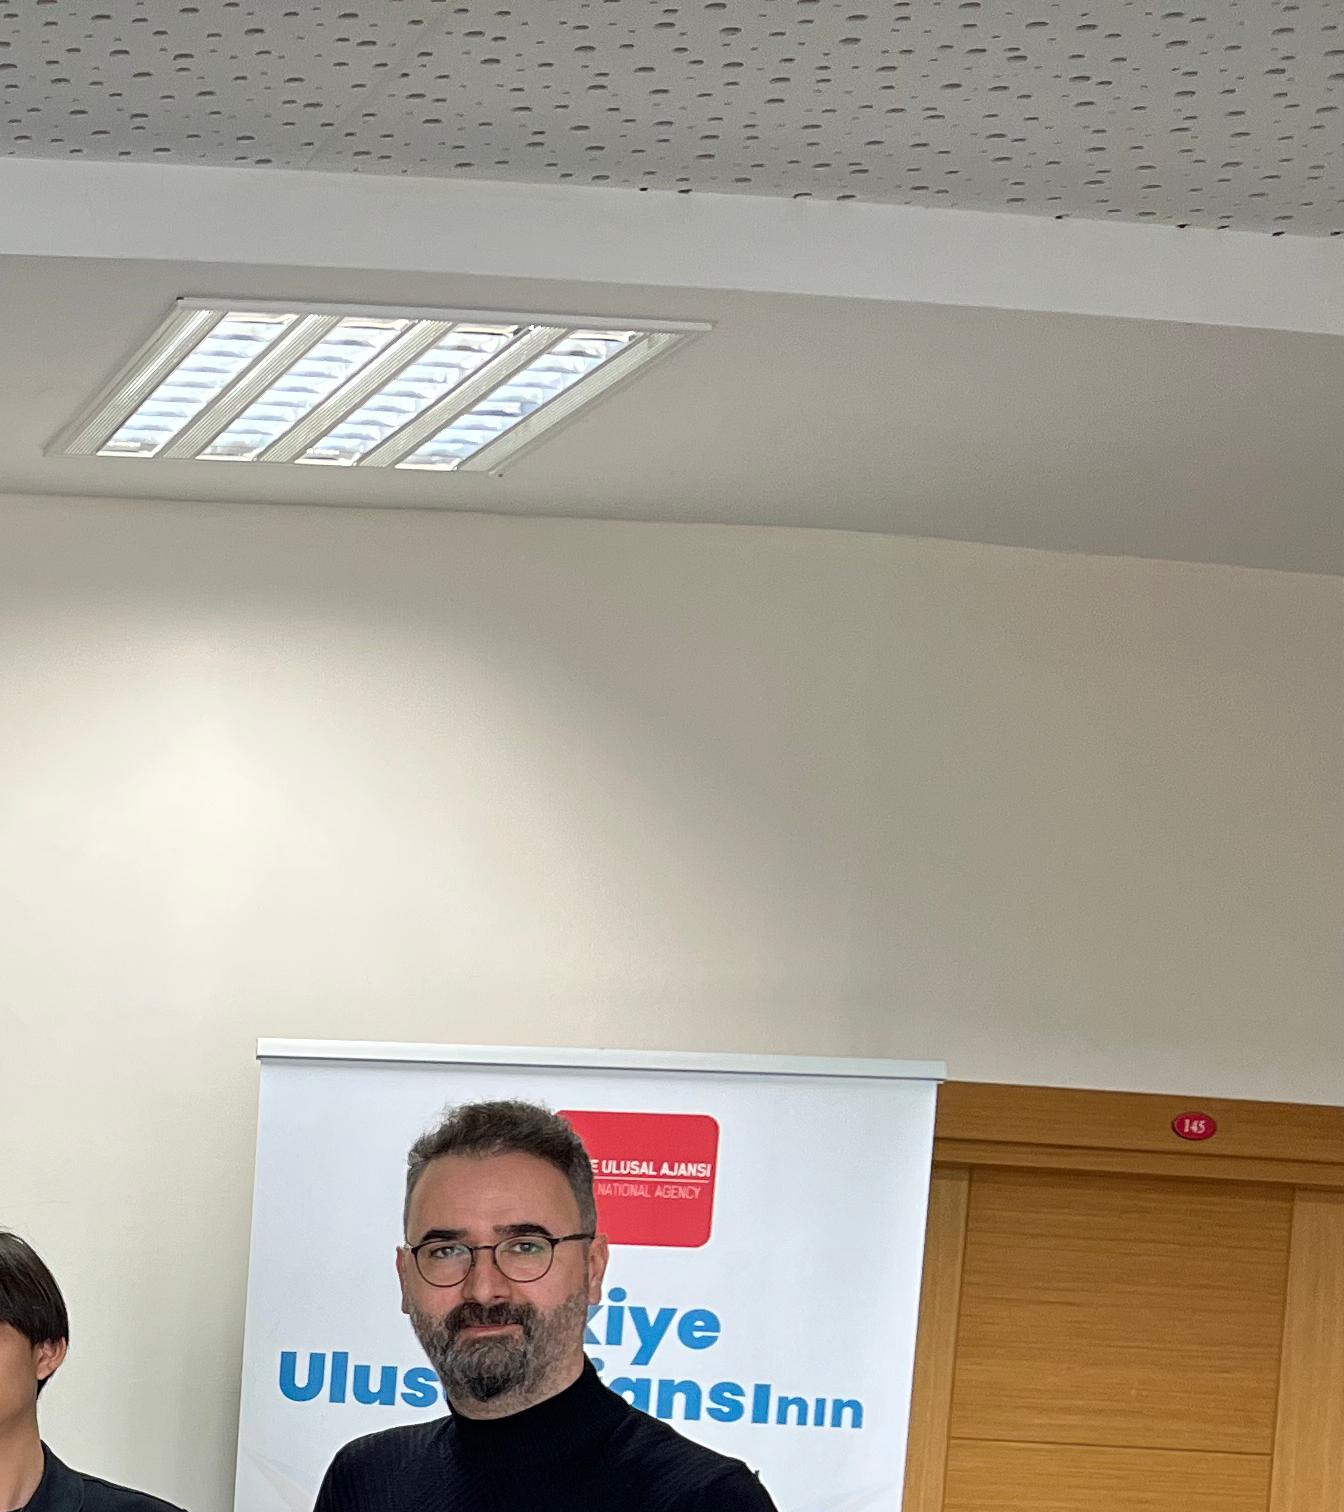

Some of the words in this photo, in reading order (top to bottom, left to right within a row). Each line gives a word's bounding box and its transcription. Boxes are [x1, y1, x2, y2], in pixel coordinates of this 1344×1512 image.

[1183, 1118, 1206, 1134] 145
[602, 1159, 657, 1176] ULUSAL
[660, 1162, 712, 1177] AJANSI
[597, 1182, 651, 1198] NATIONAL
[654, 1184, 702, 1200] AGENCY
[279, 1351, 444, 1408] Ulus
[596, 1362, 863, 1429] ansının
